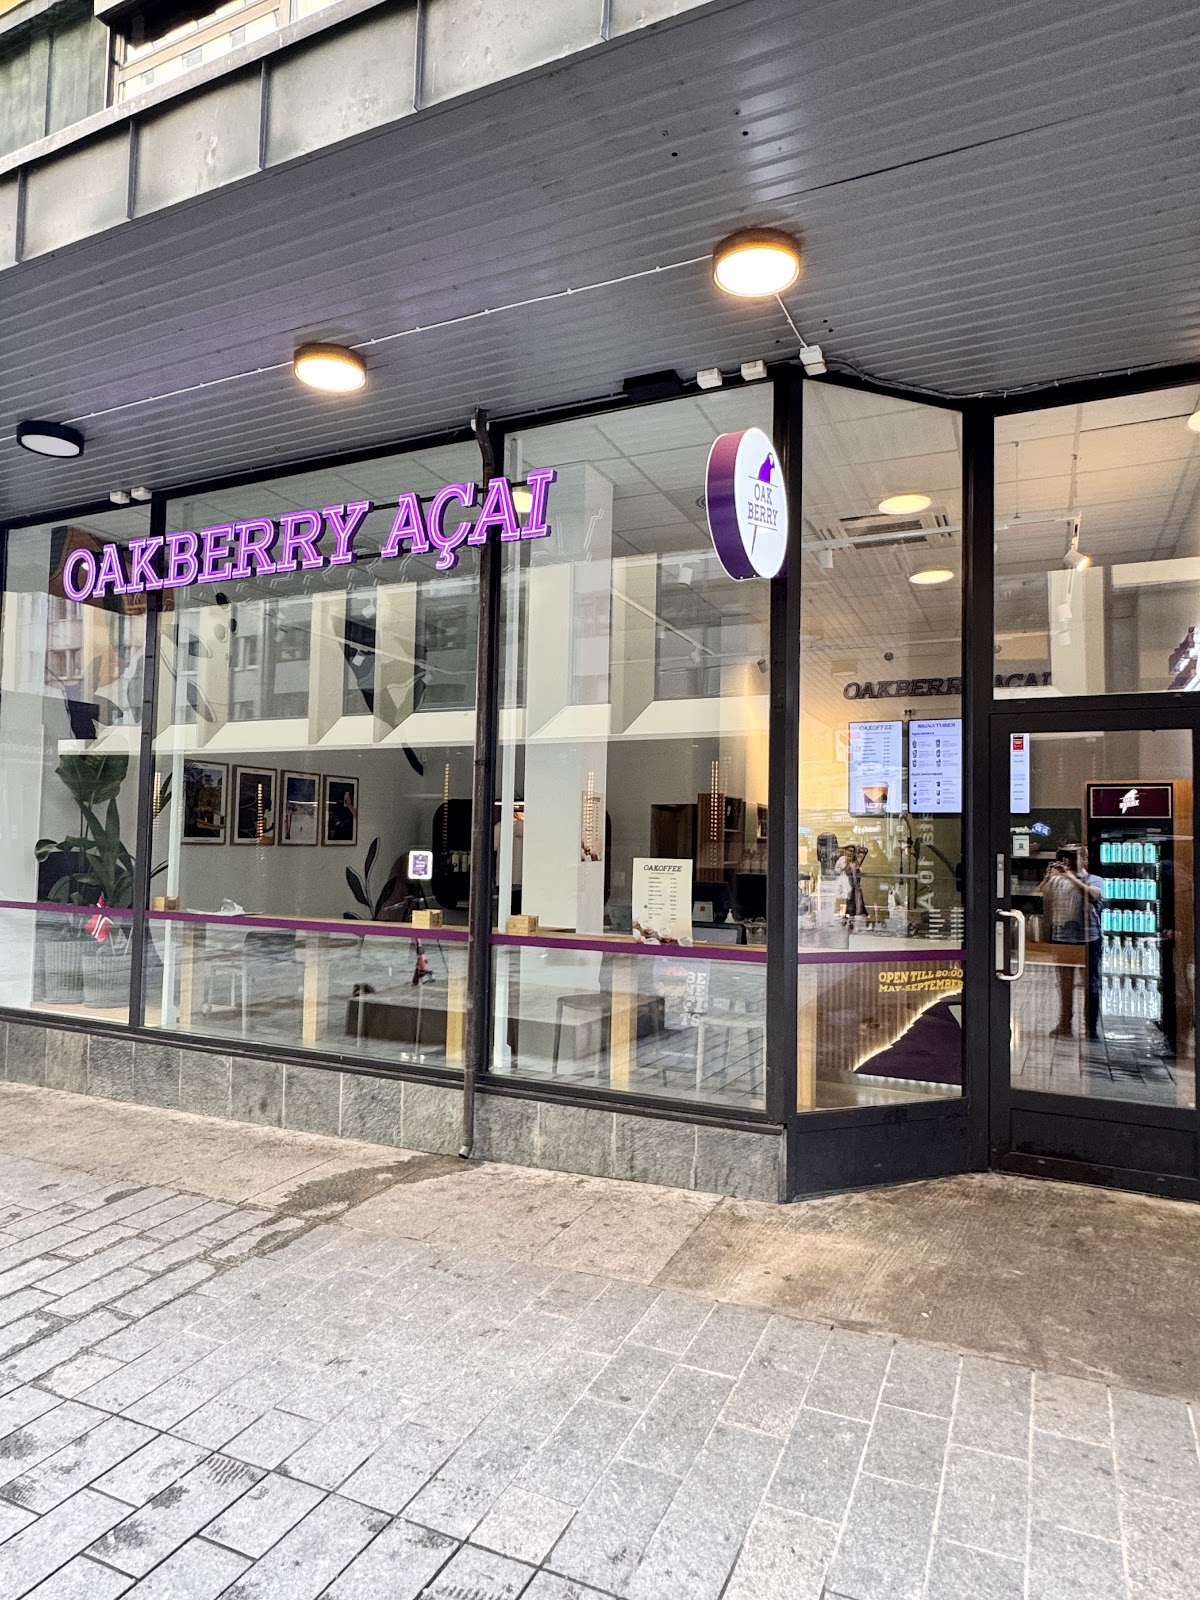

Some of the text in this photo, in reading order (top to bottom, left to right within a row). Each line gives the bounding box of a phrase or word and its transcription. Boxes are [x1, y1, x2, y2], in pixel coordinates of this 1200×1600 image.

[754, 483, 773, 505] OAK
[747, 501, 778, 527] BERRY
[63, 469, 558, 602] OAKBERRY AÇAI
[843, 677, 963, 700] OAKBERR
[643, 864, 683, 873] OAKOFFEE
[878, 968, 964, 984] OPEN TILL 20:00
[878, 978, 964, 993] MAY-SEPTEMBER
